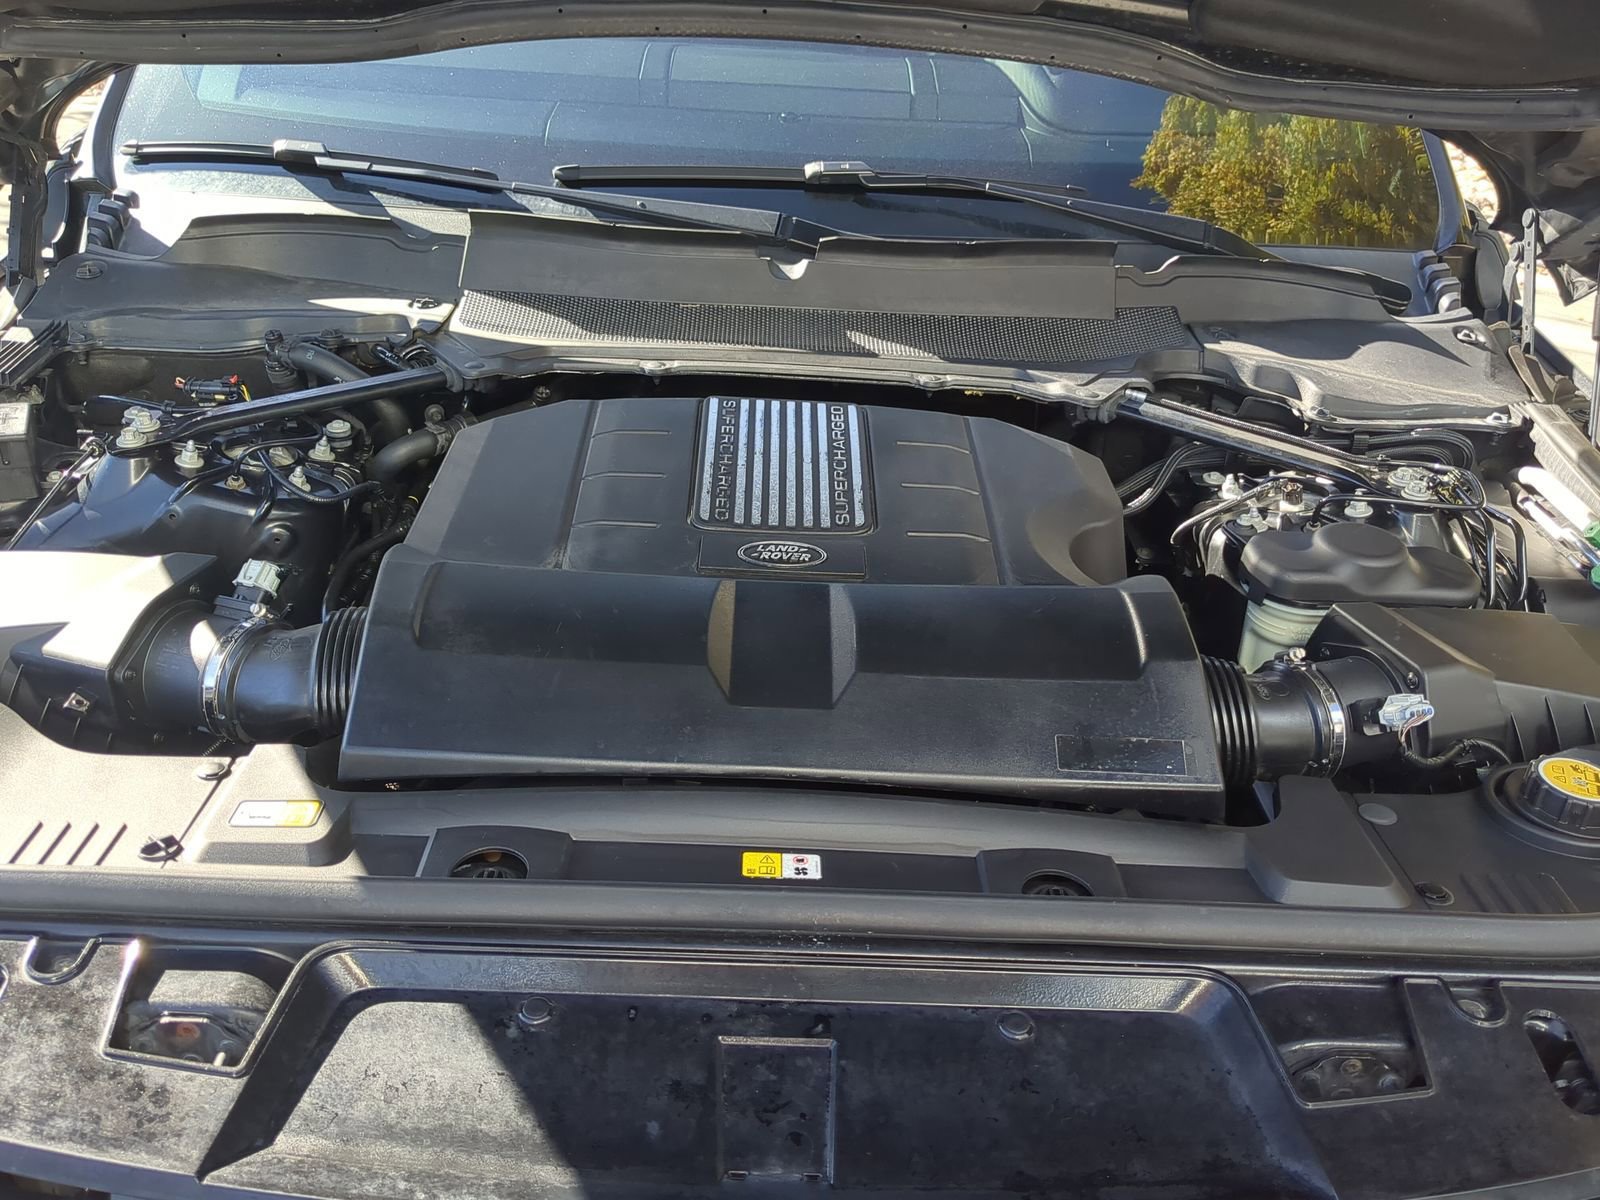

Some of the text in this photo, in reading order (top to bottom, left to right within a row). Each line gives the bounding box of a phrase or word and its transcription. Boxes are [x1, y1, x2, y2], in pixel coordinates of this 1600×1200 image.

[714, 400, 736, 520] SUPERCHARGED
[830, 405, 850, 525] SUPERCHARGED
[757, 544, 800, 553] LAND
[760, 552, 811, 561] ROVER
